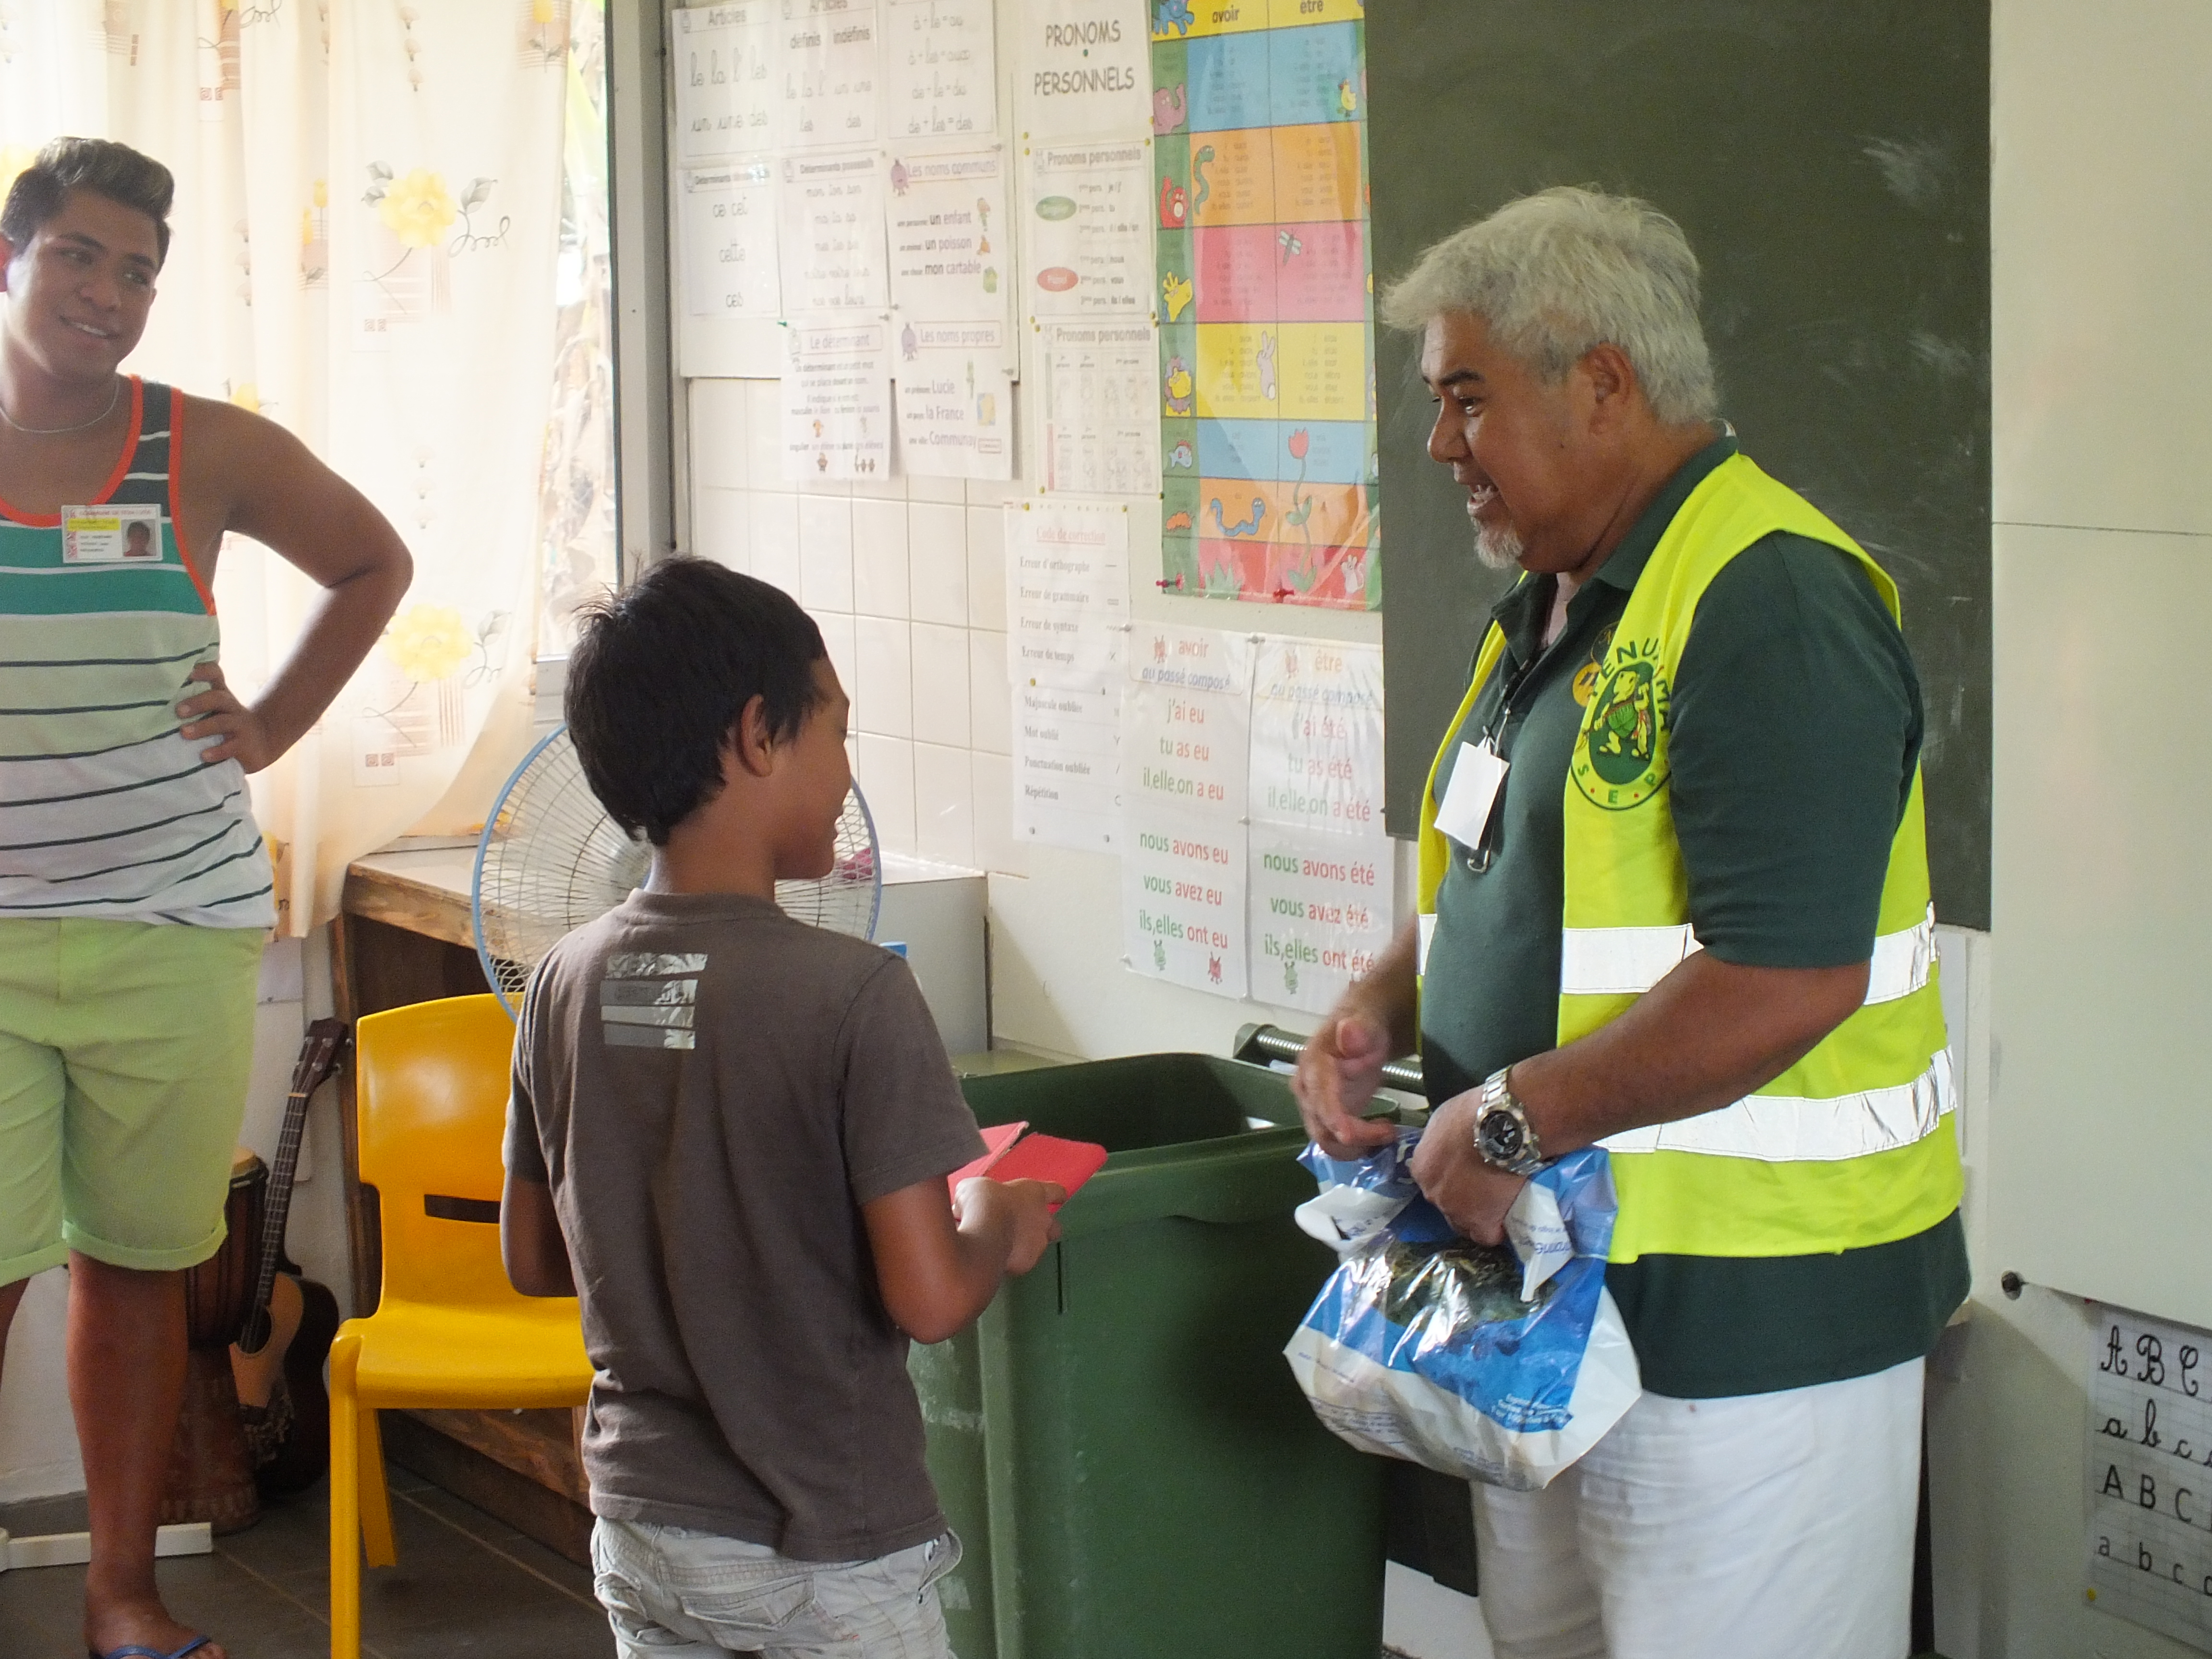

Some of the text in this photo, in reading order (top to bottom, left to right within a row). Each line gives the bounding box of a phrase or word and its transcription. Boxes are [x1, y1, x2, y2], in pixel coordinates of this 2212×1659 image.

[708, 9, 746, 25] Articles
[1213, 5, 1239, 23] avoir
[1045, 20, 1121, 48] PRONOMS
[690, 51, 704, 87] le
[711, 49, 726, 84] la
[1034, 66, 1135, 96] PERSONNELS
[1047, 147, 1141, 167] Pronoms personnels
[906, 160, 996, 177] Les noms communs
[930, 214, 941, 225] un
[943, 209, 971, 225] enfant
[720, 239, 745, 263] cette
[925, 240, 936, 250] un
[939, 235, 972, 253] poisson
[925, 264, 944, 275] mon
[946, 259, 981, 275] cartable
[810, 333, 870, 349] Le déterminant
[921, 328, 994, 345] Les noms propres
[1057, 326, 1151, 345] Pronoms personnels
[932, 378, 955, 394] Lucie
[926, 404, 934, 420] la
[936, 405, 964, 420] France
[929, 431, 976, 449] Communay
[1036, 526, 1106, 542] Code de correction
[1020, 556, 1041, 568] Erreur
[1020, 586, 1089, 603] Erreur de grammaire
[1021, 616, 1079, 635] Erreur de syntaxe
[1022, 645, 1075, 664] Erreur de temps
[1178, 638, 1209, 659] avoir
[1315, 651, 1343, 672] être
[1142, 667, 1231, 691] au passé composé
[1271, 683, 1374, 706] au passé composé
[1167, 698, 1205, 724] j'ai eu
[1024, 725, 1038, 737] Mot
[1293, 712, 1345, 740] j'ai été
[1159, 736, 1210, 762] tu as eu
[1025, 755, 1064, 771] Ponctuation
[1288, 753, 1353, 780] tu as été
[1025, 784, 1059, 800] Répétition
[1196, 781, 1204, 797] a
[1208, 783, 1224, 801] eu
[1333, 800, 1341, 817] a
[1346, 798, 1371, 822] été
[1140, 832, 1229, 865] nous avons eu
[1263, 854, 1375, 886] nous avons été
[1143, 875, 1223, 906] vous avez eu
[1271, 897, 1369, 929] vous avez été
[1187, 925, 1209, 946] ont
[1212, 931, 1228, 950] eu
[1322, 948, 1346, 970] ont
[1352, 948, 1373, 973] été
[2101, 1325, 2128, 1376] A
[2136, 1334, 2165, 1386] B
[2101, 1398, 2192, 1459] a b c
[2103, 1465, 2191, 1523] A B C
[2097, 1537, 2183, 1585] a b c
